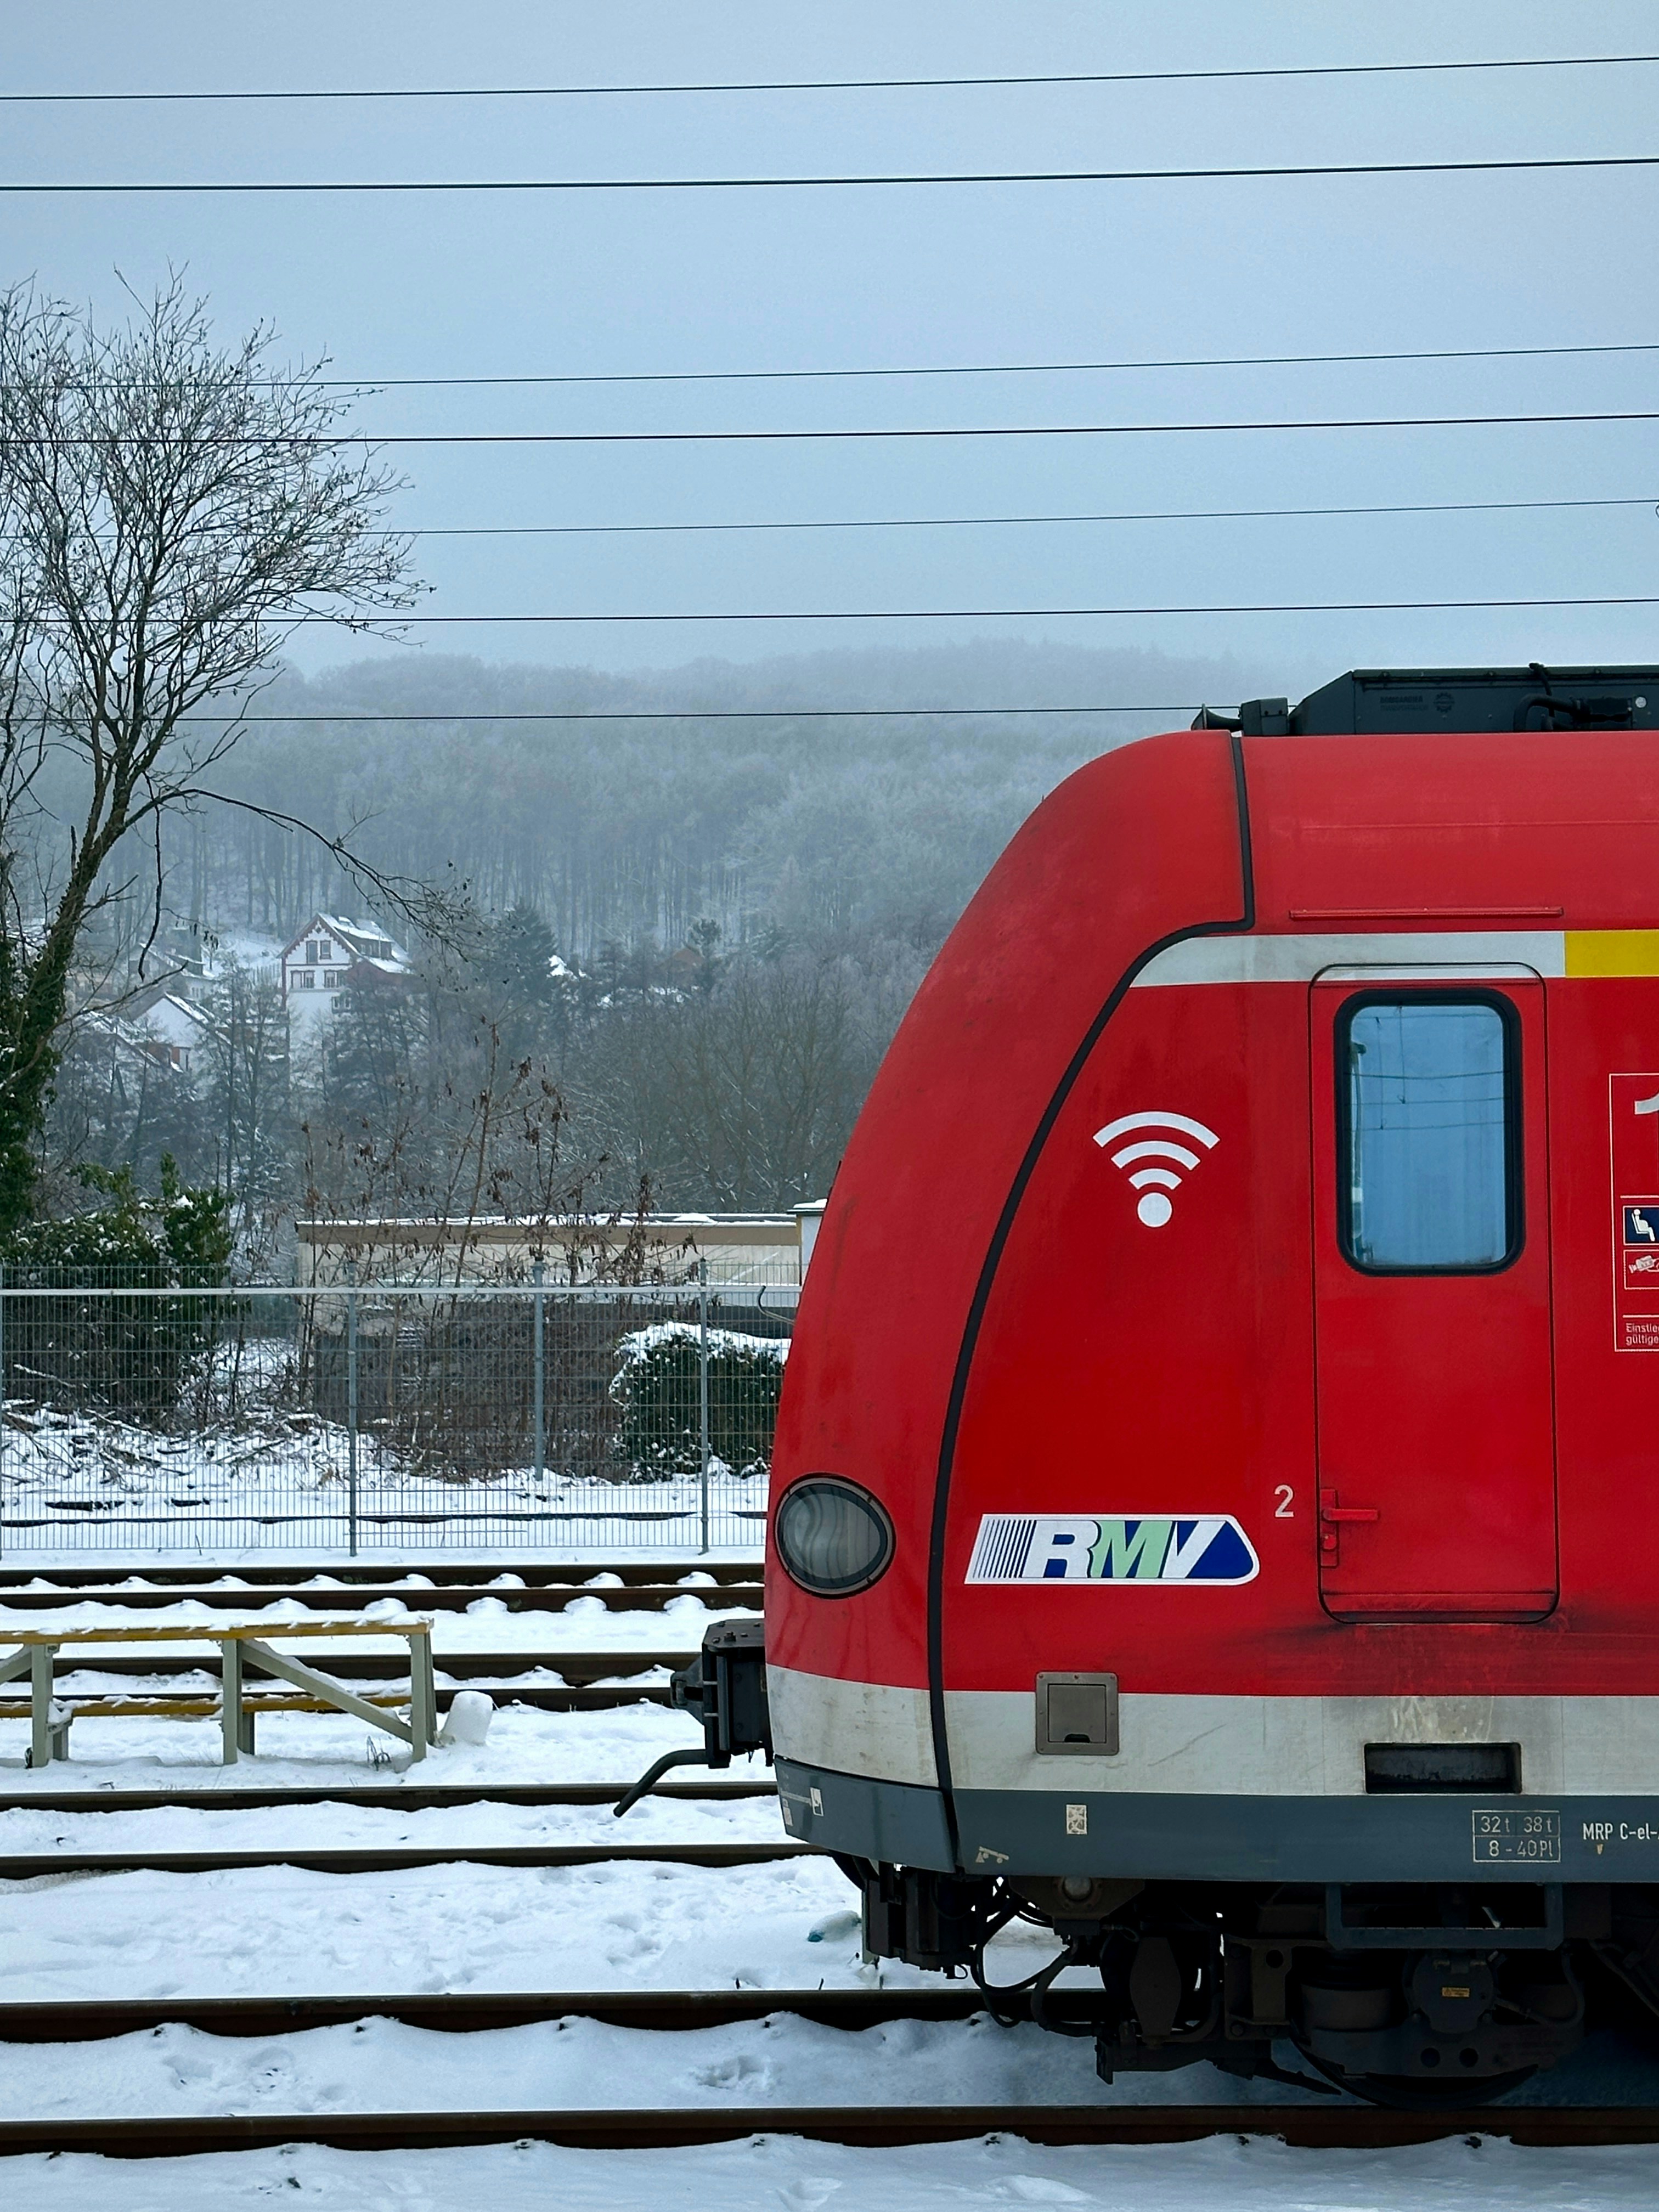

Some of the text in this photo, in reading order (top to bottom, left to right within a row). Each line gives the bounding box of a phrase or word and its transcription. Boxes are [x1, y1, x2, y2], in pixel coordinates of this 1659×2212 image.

[1626, 1323, 1659, 1334] Einstie
[1274, 1484, 1295, 1518] 2
[1022, 1520, 1226, 1578] RMV
[1583, 1822, 1659, 1840] MRP C-el-
